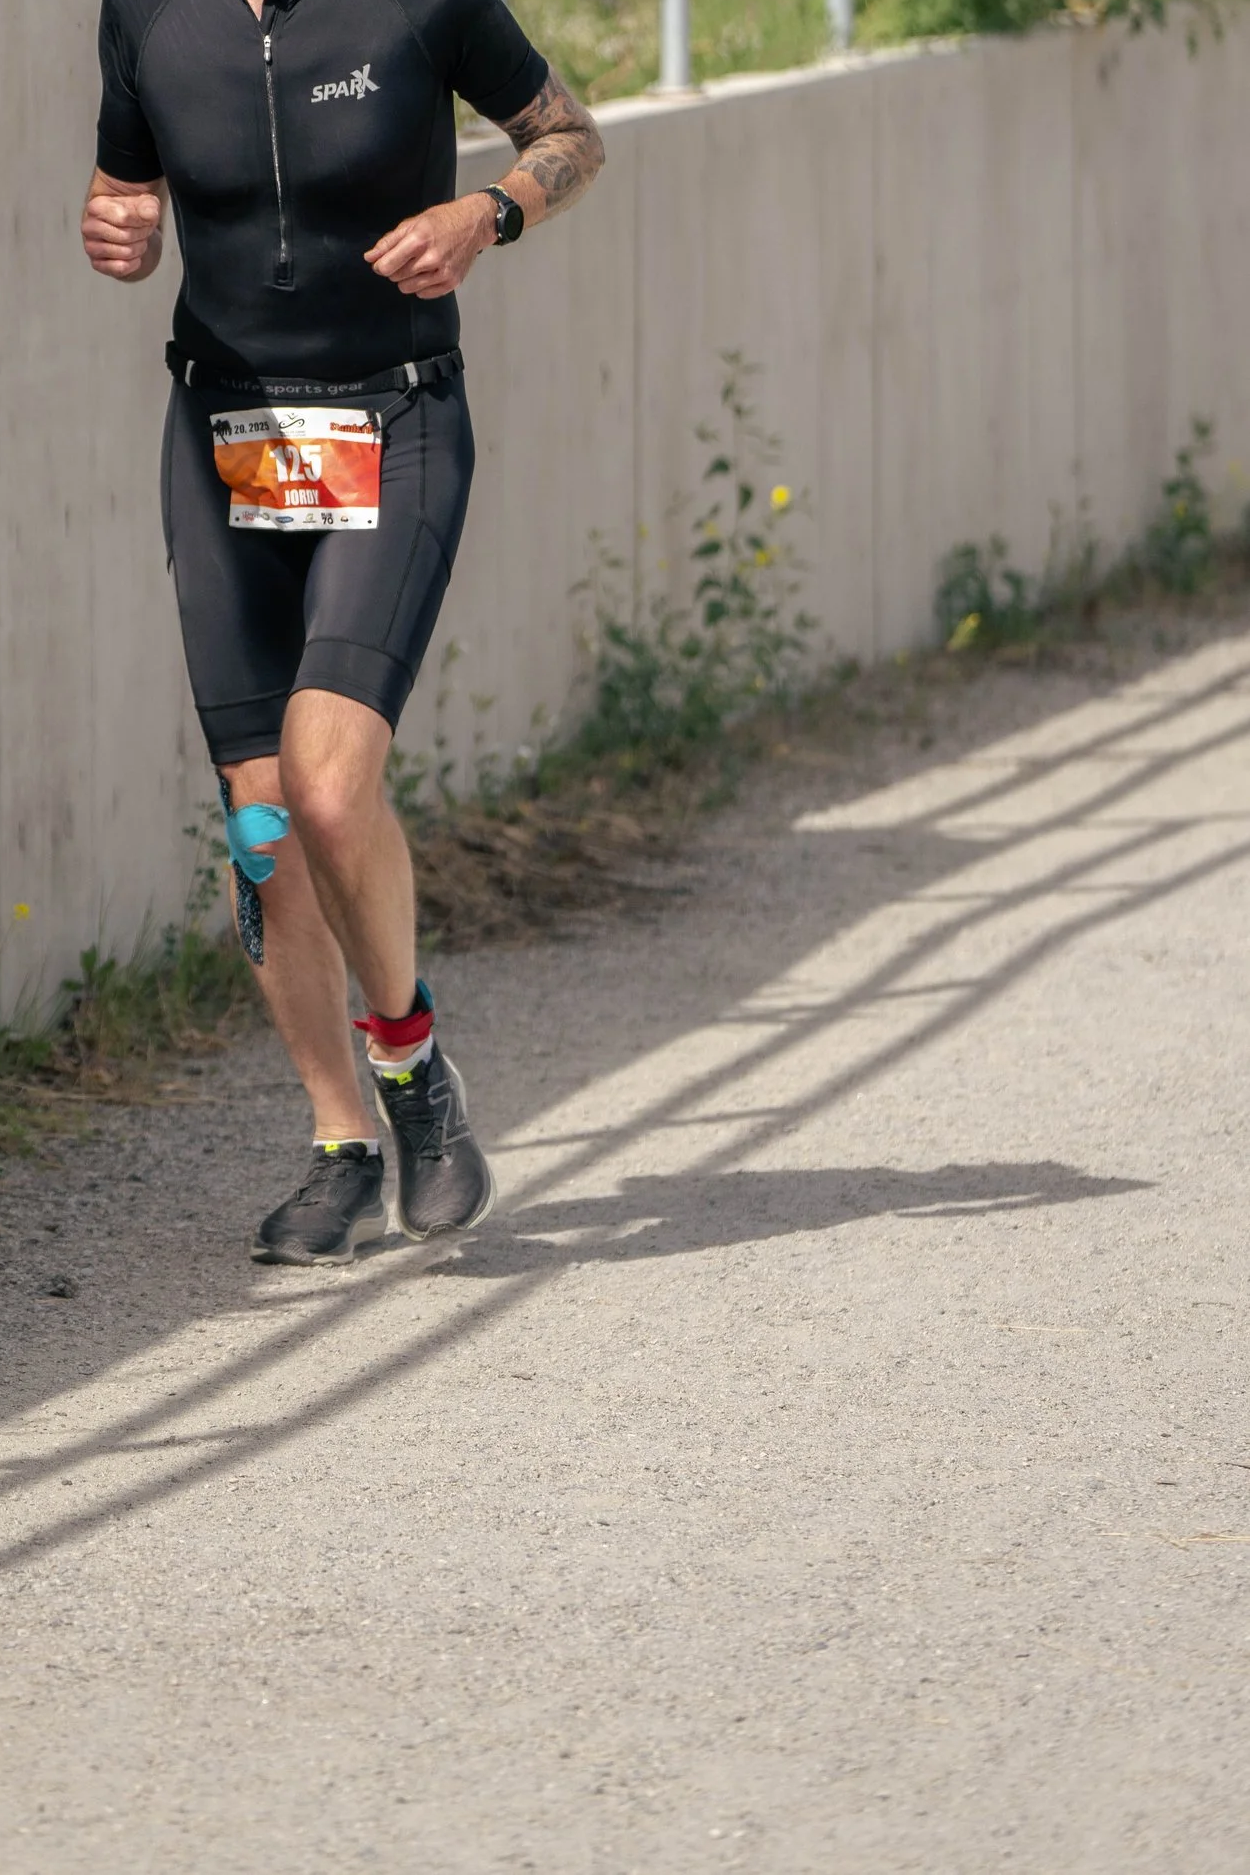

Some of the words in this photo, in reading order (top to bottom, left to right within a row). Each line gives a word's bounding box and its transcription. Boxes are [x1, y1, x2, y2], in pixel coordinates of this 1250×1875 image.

[265, 382, 322, 396] sports
[327, 381, 366, 396] gear
[248, 420, 270, 433] 2025
[269, 444, 323, 483] 125
[284, 488, 320, 506] JORDY
[321, 517, 334, 525] 70
